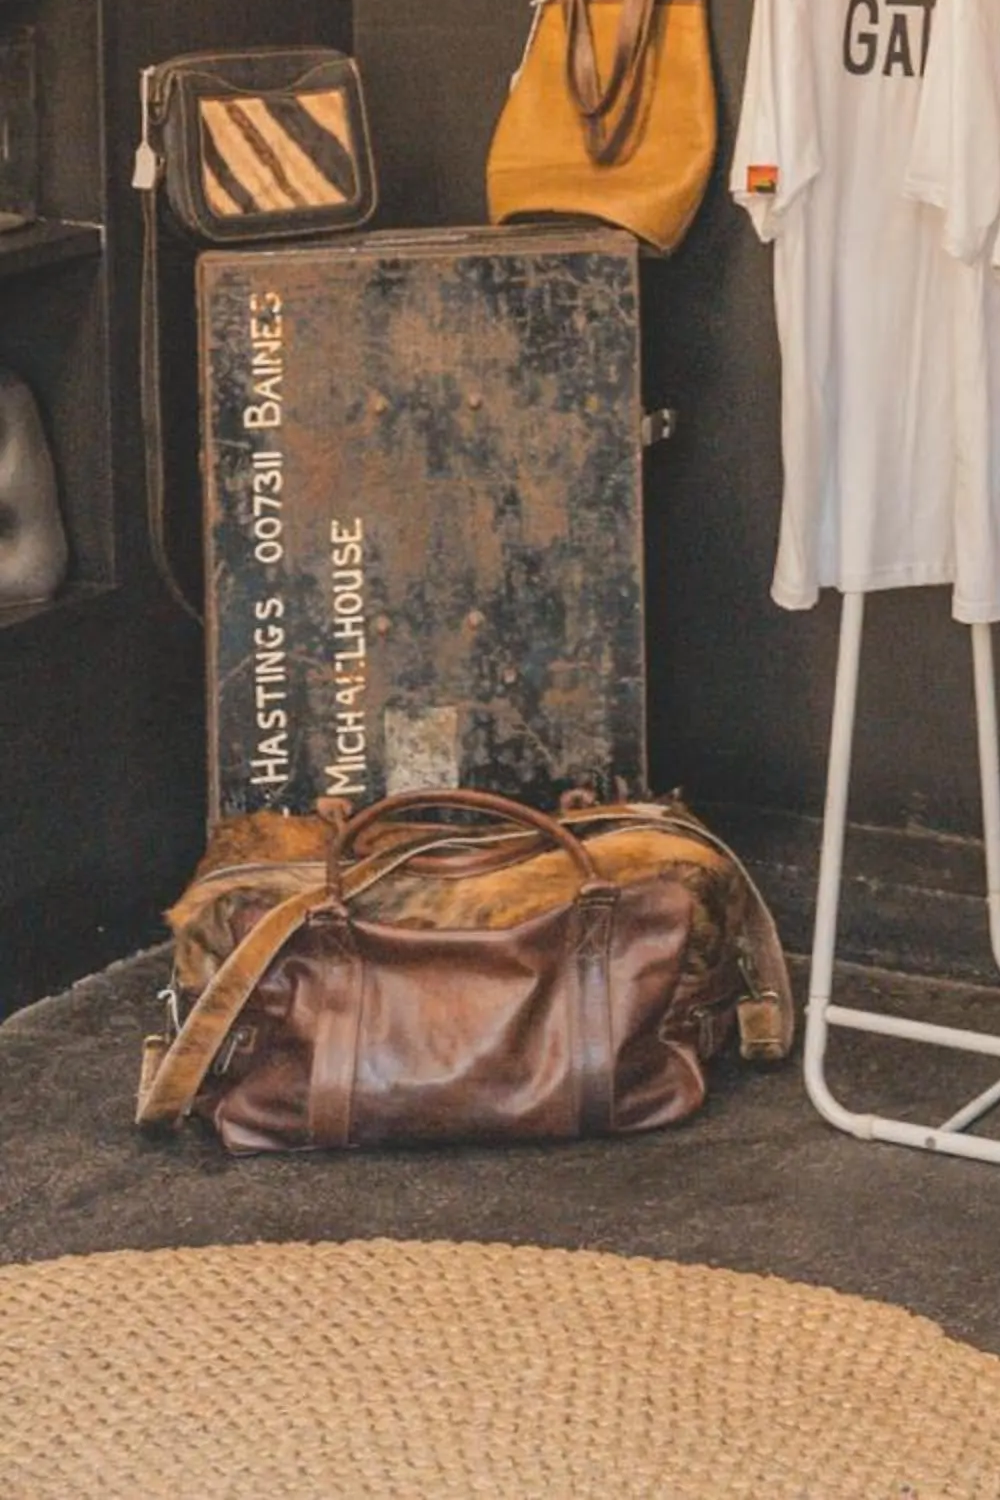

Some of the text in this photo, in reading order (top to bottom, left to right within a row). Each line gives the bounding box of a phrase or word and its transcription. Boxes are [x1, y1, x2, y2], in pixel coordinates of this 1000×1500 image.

[244, 292, 288, 785] HASTINGS 007311 BAINES
